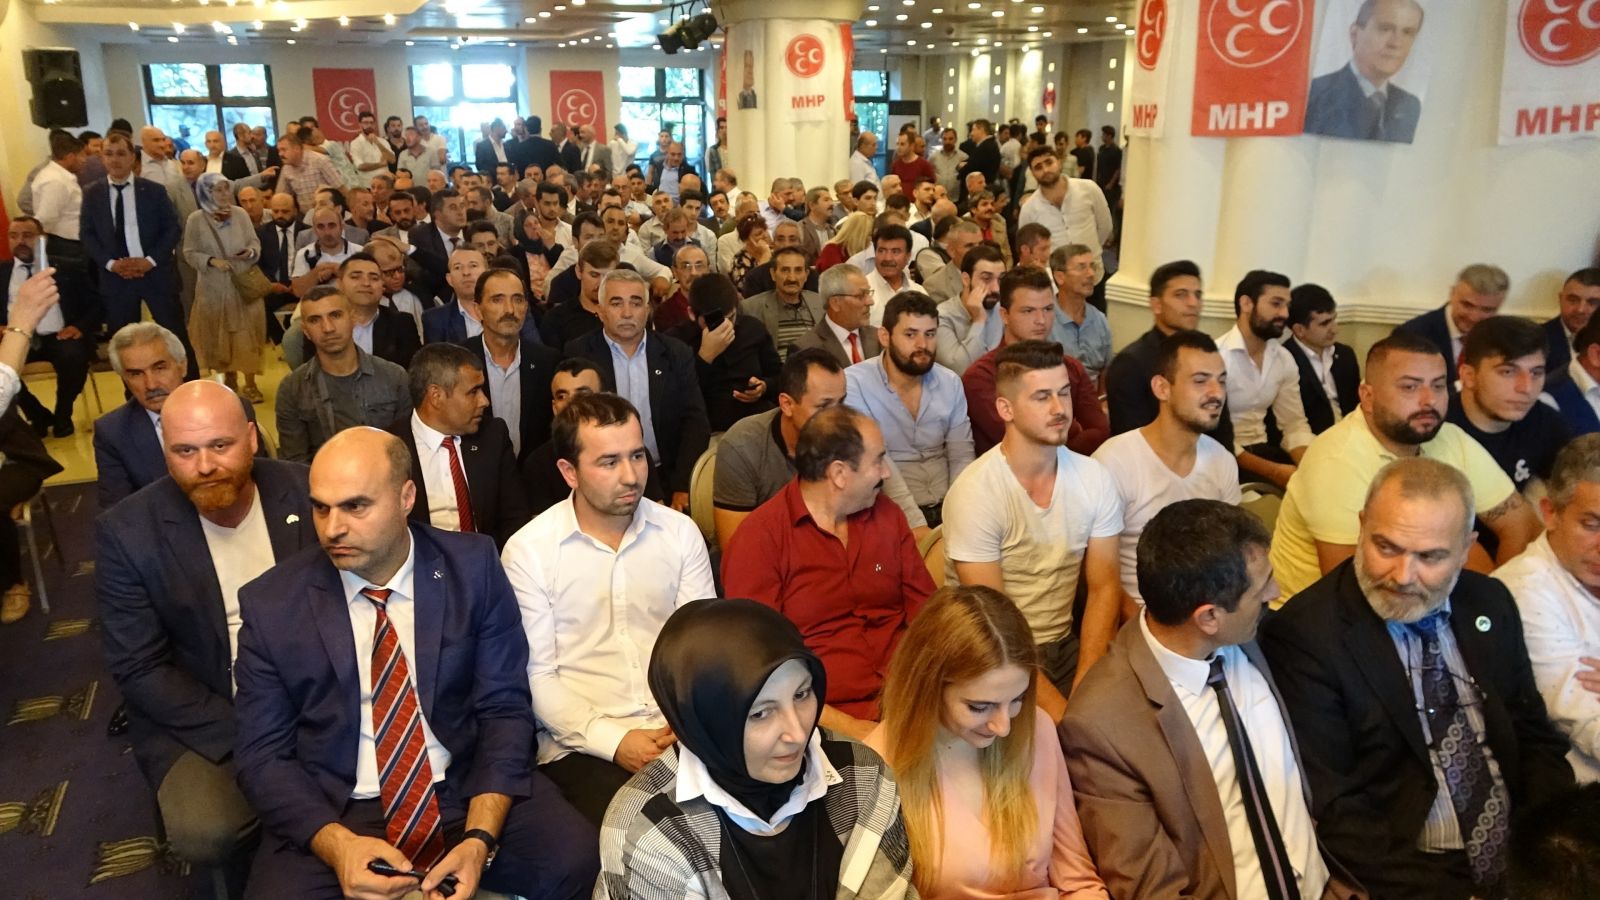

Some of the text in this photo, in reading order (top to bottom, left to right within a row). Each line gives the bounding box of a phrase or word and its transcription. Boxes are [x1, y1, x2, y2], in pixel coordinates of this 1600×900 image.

[792, 95, 825, 108] MHP
[1133, 104, 1157, 128] MHP
[1208, 101, 1289, 130] MHP
